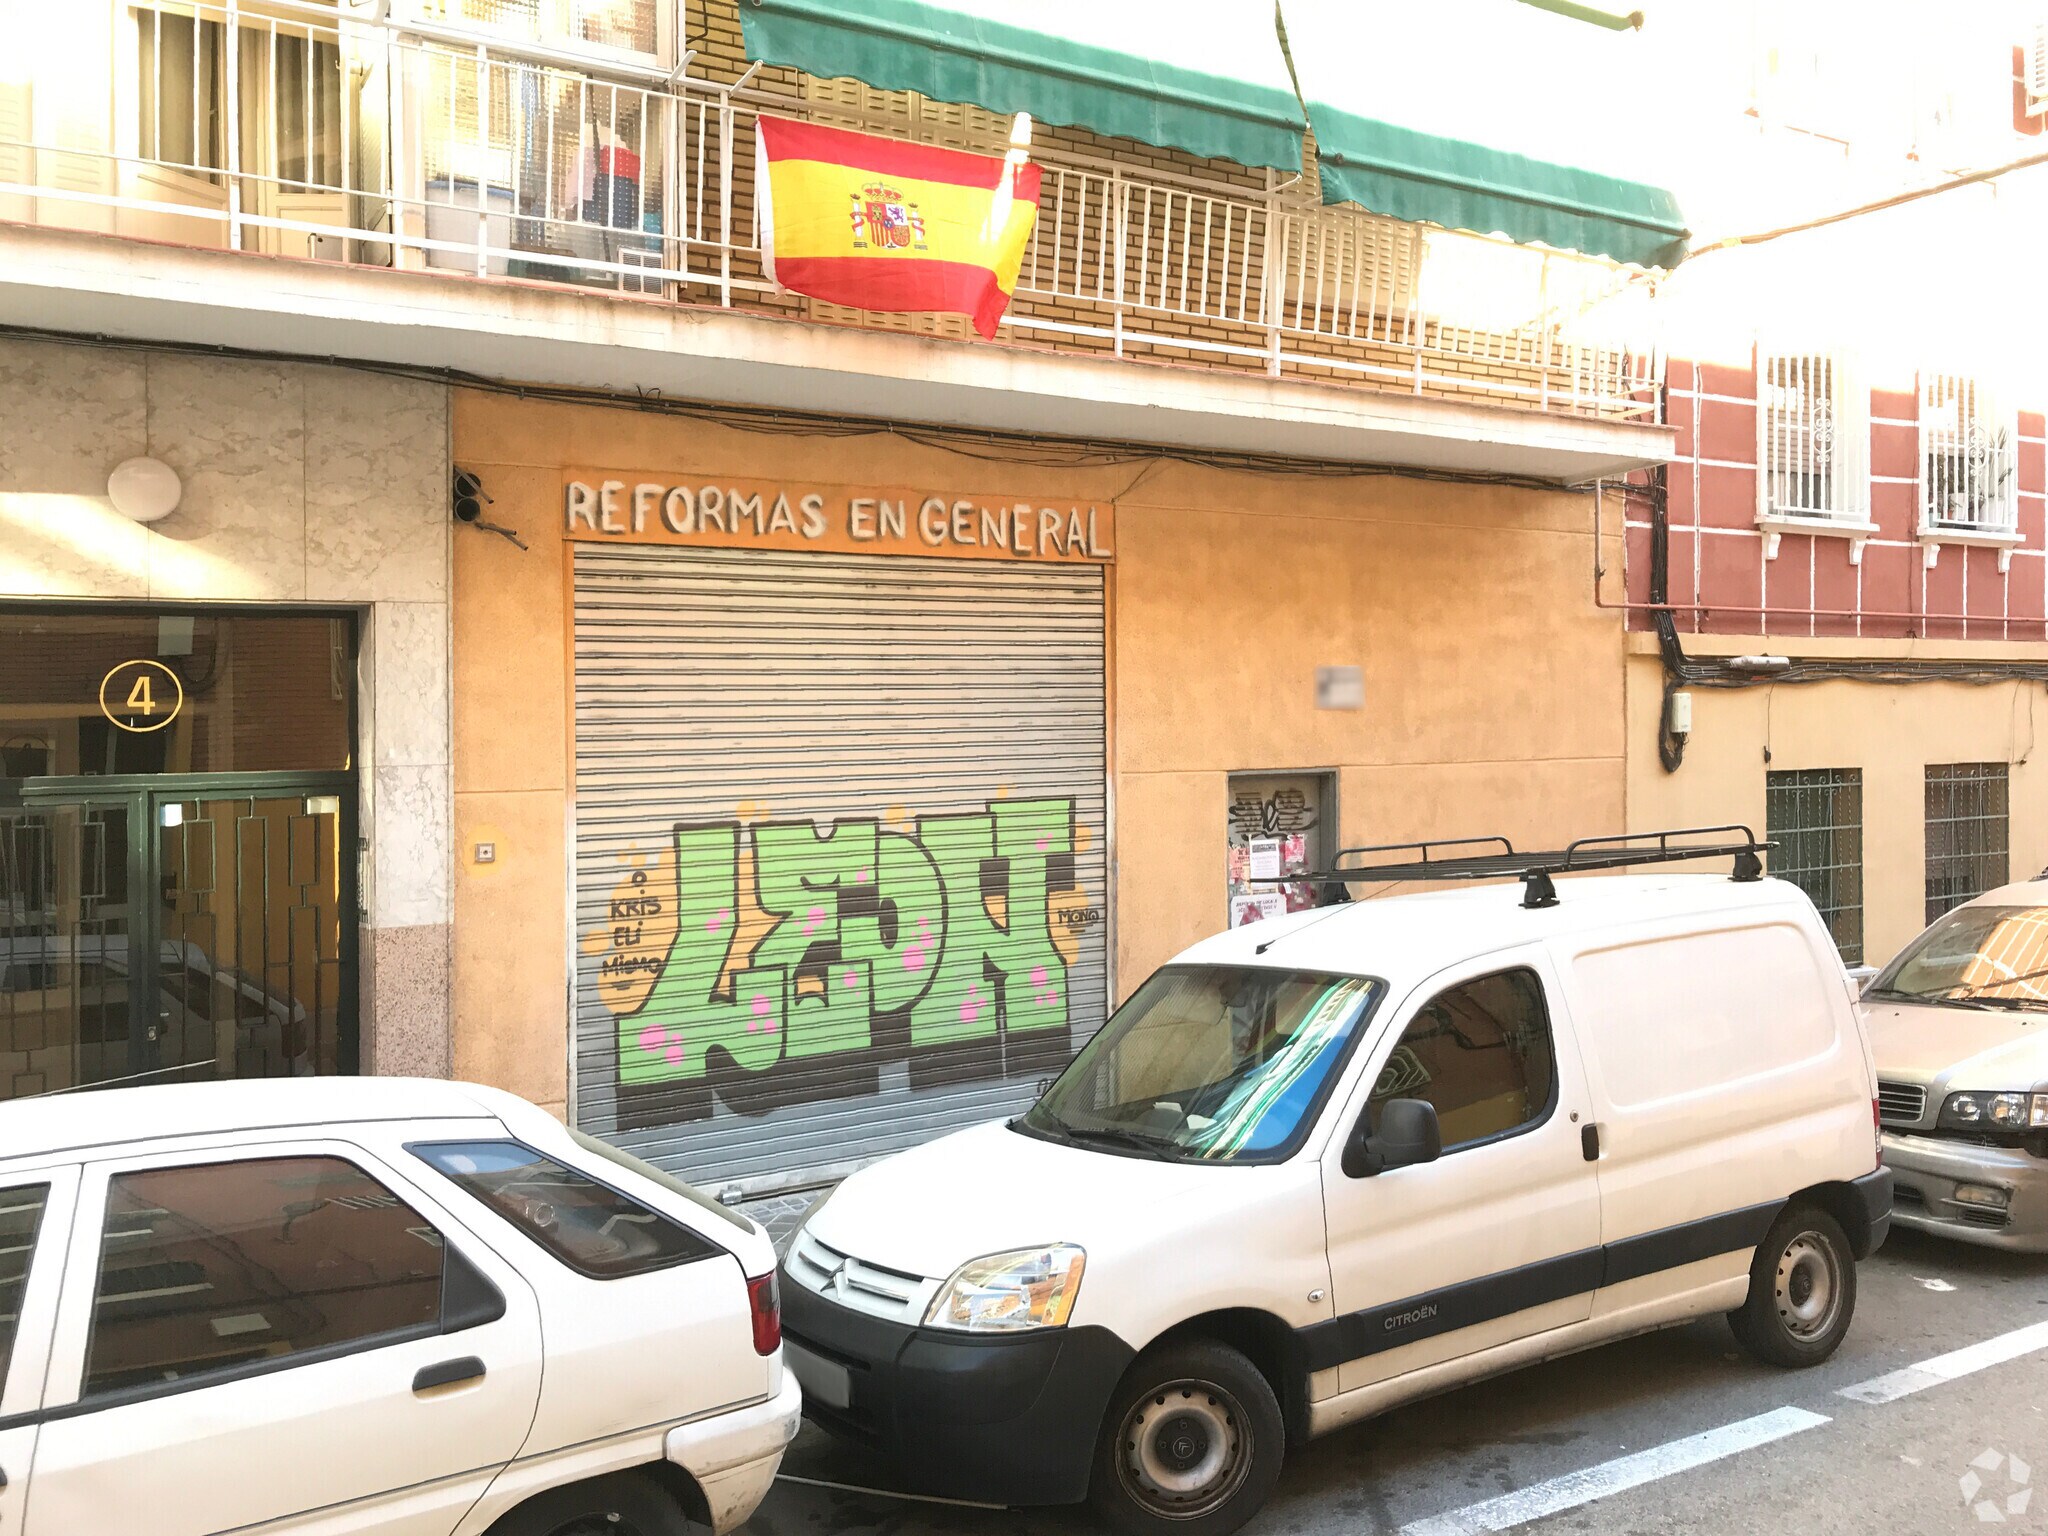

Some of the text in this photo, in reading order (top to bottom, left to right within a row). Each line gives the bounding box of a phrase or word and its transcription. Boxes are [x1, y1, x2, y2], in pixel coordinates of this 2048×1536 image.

[566, 479, 1113, 558] REFORMAS EN GENERAL
[127, 676, 155, 715] 4
[1384, 1304, 1438, 1330] CITROËN
